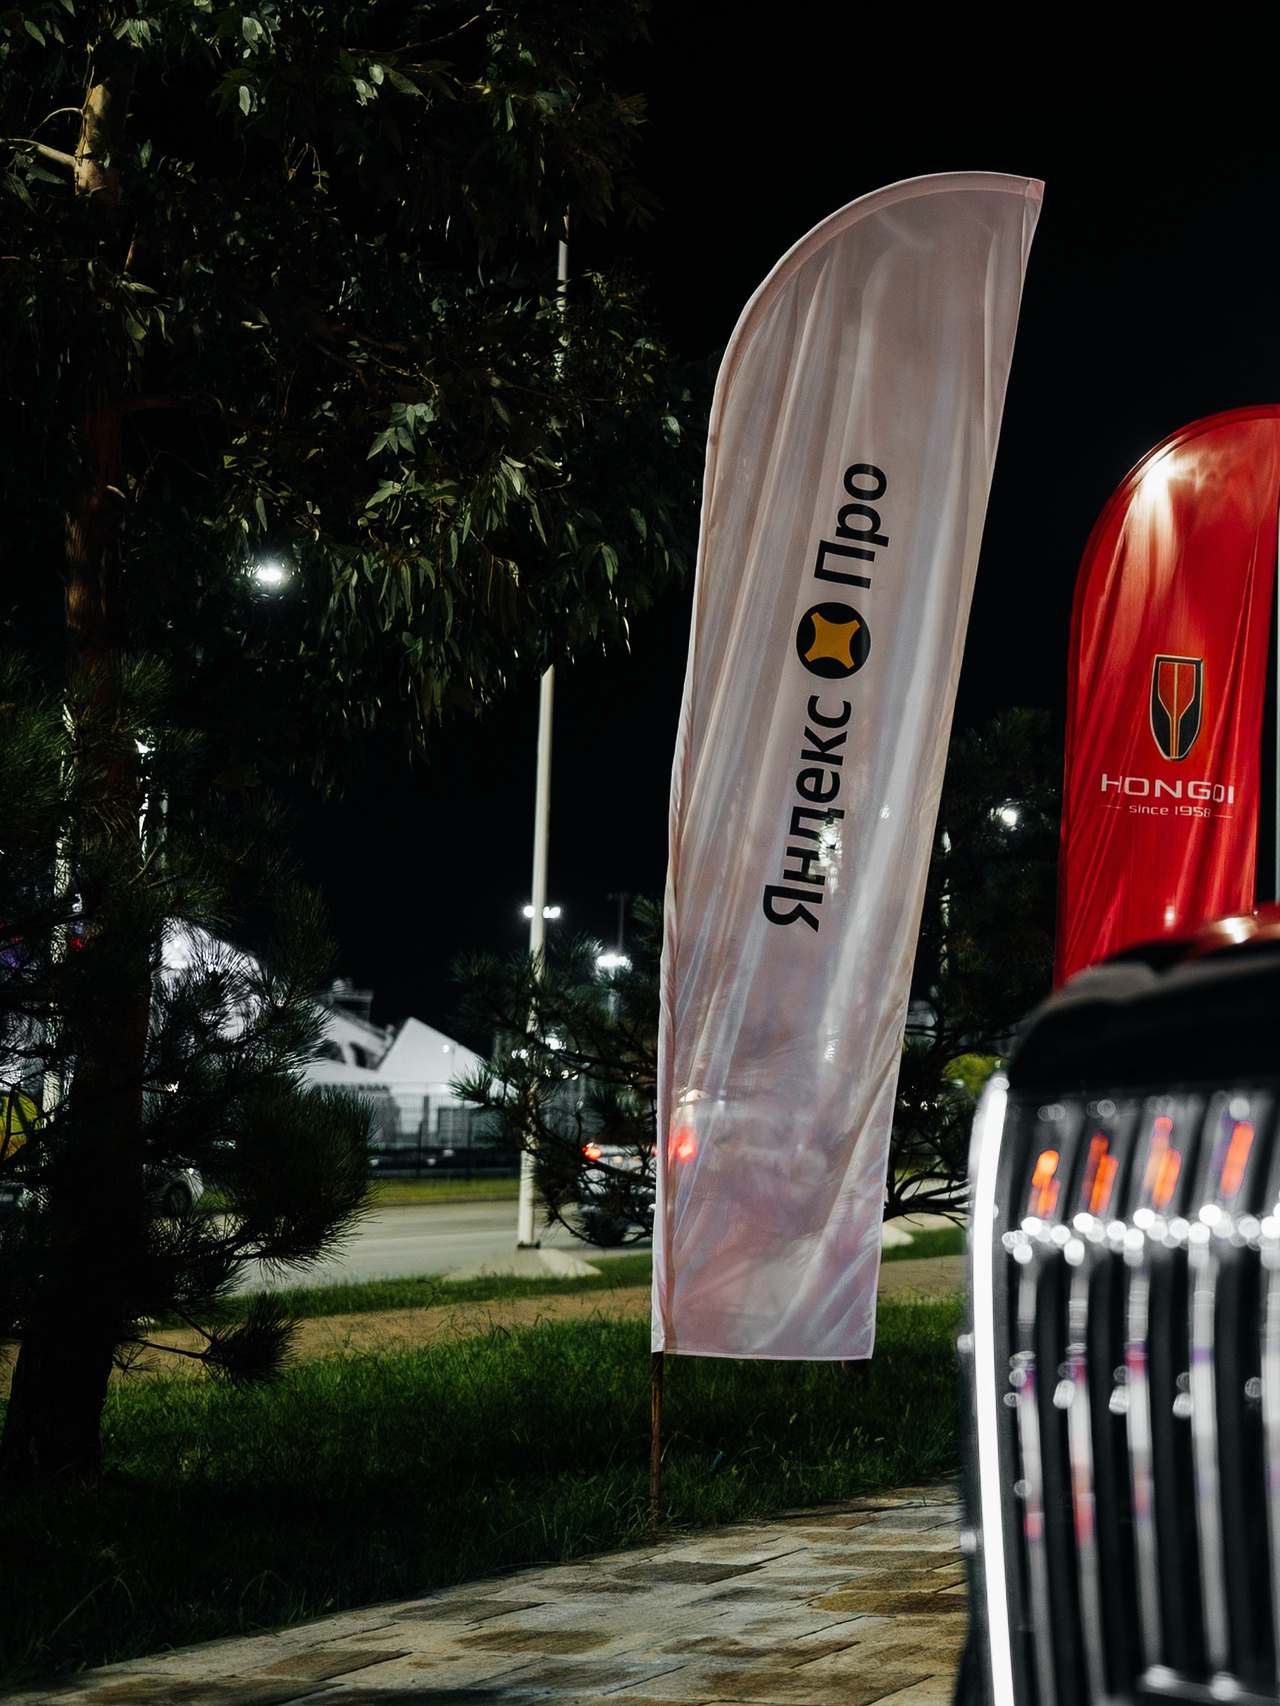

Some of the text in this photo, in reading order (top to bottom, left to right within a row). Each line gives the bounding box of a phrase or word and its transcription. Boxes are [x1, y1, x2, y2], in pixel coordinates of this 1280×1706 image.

[763, 462, 890, 932] Яндекс Про
[1101, 773, 1235, 804] HONGQI
[1129, 804, 1211, 818] since 1958
